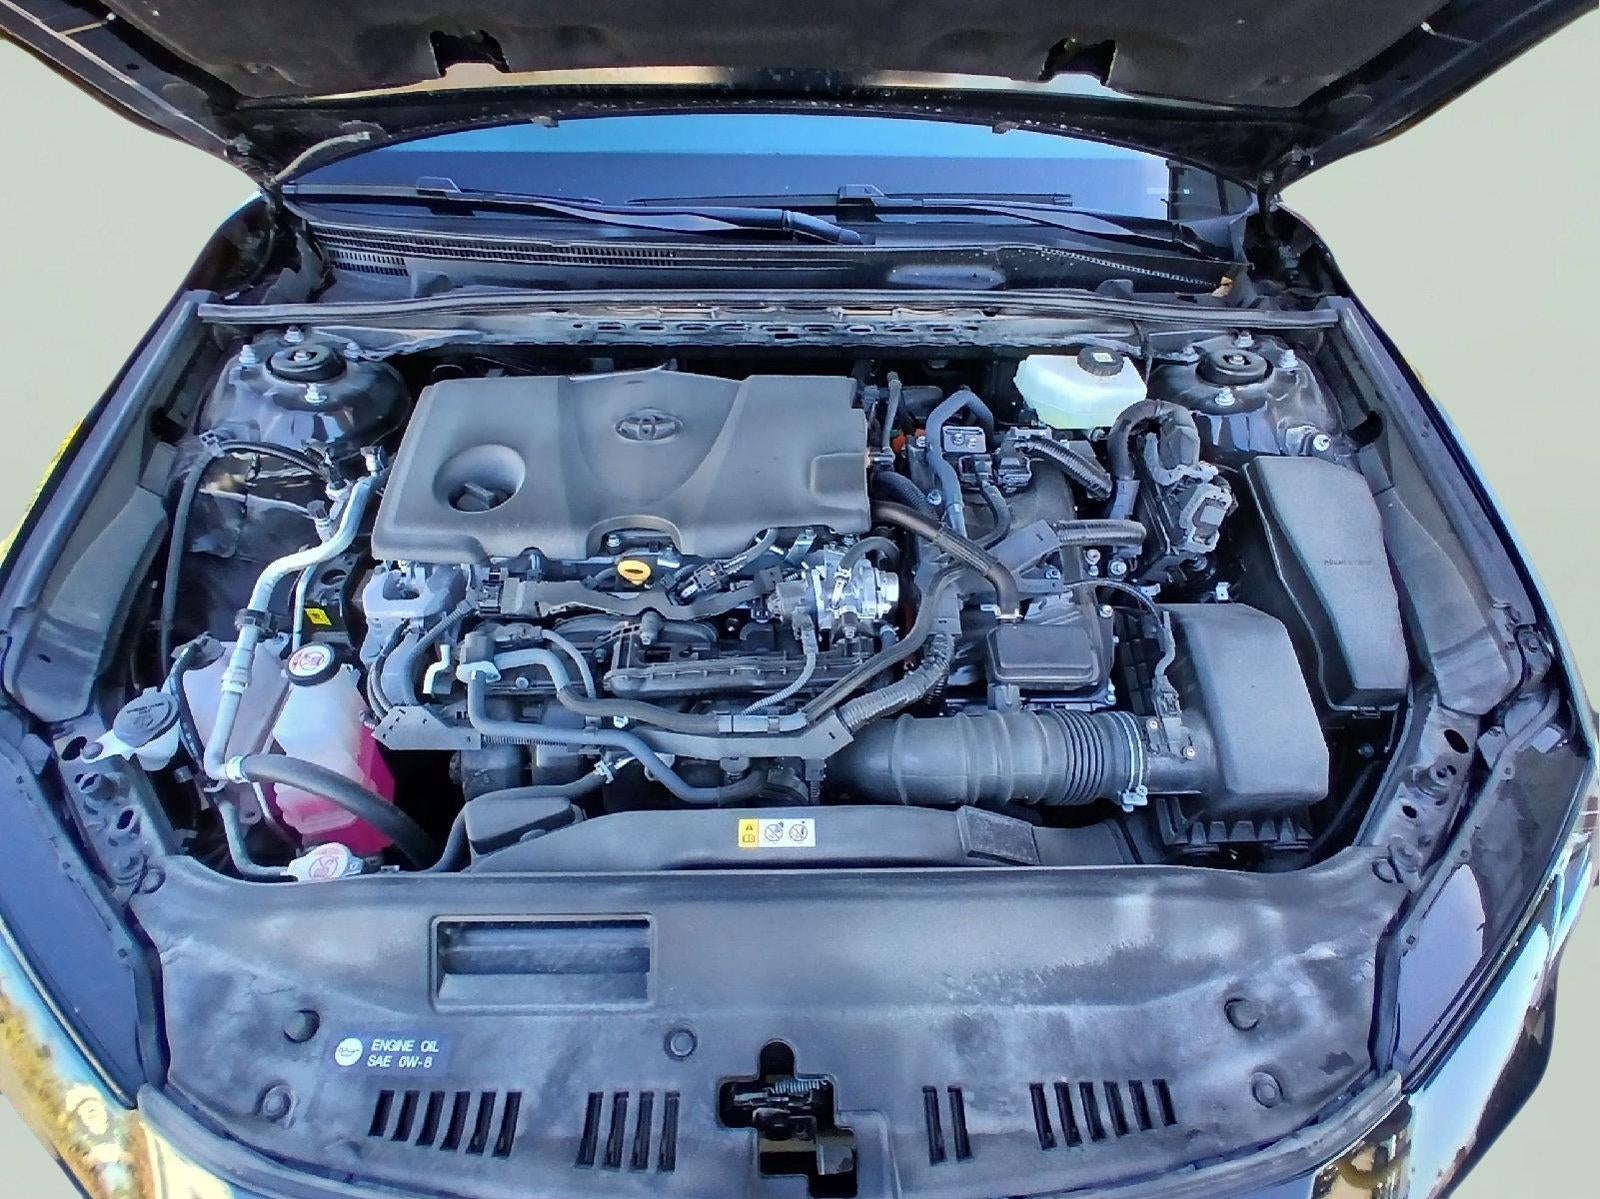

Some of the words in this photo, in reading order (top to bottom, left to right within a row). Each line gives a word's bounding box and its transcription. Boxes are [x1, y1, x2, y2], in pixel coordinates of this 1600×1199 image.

[371, 1039, 415, 1052] ENGINE
[420, 1040, 440, 1053] OIL
[367, 1054, 392, 1068] SAE
